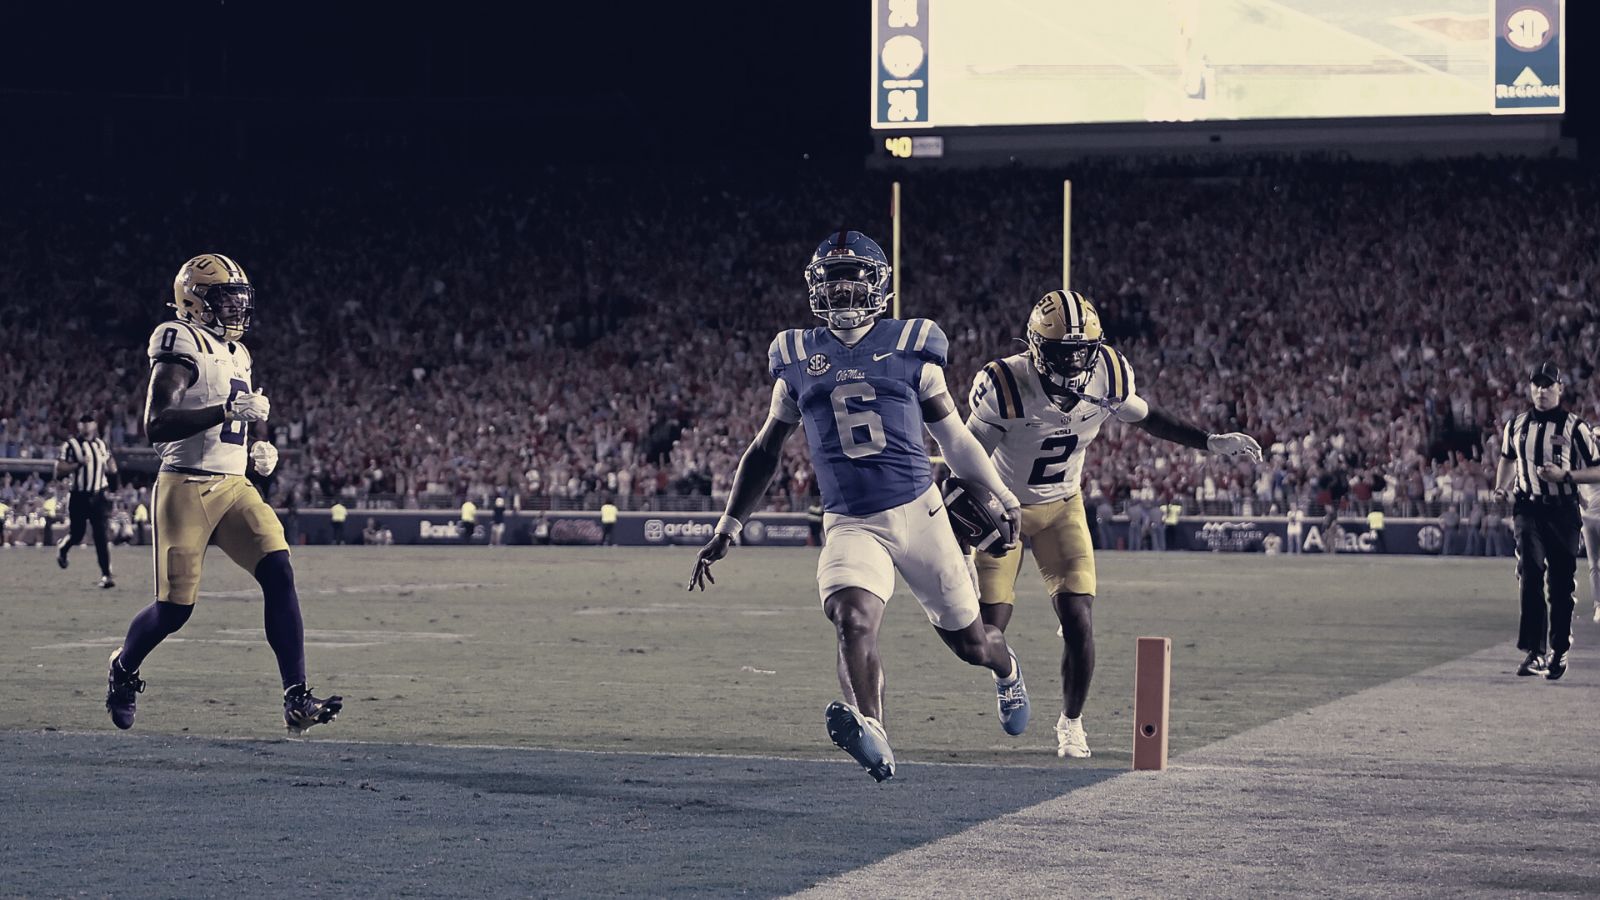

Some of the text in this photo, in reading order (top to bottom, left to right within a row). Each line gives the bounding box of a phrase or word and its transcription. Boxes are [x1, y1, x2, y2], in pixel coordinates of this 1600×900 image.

[161, 327, 178, 352] 0
[809, 354, 827, 371] SEC
[972, 381, 988, 408] 2
[829, 381, 887, 459] 6
[1026, 433, 1079, 486] 2
[1231, 530, 1263, 540] RIVER
